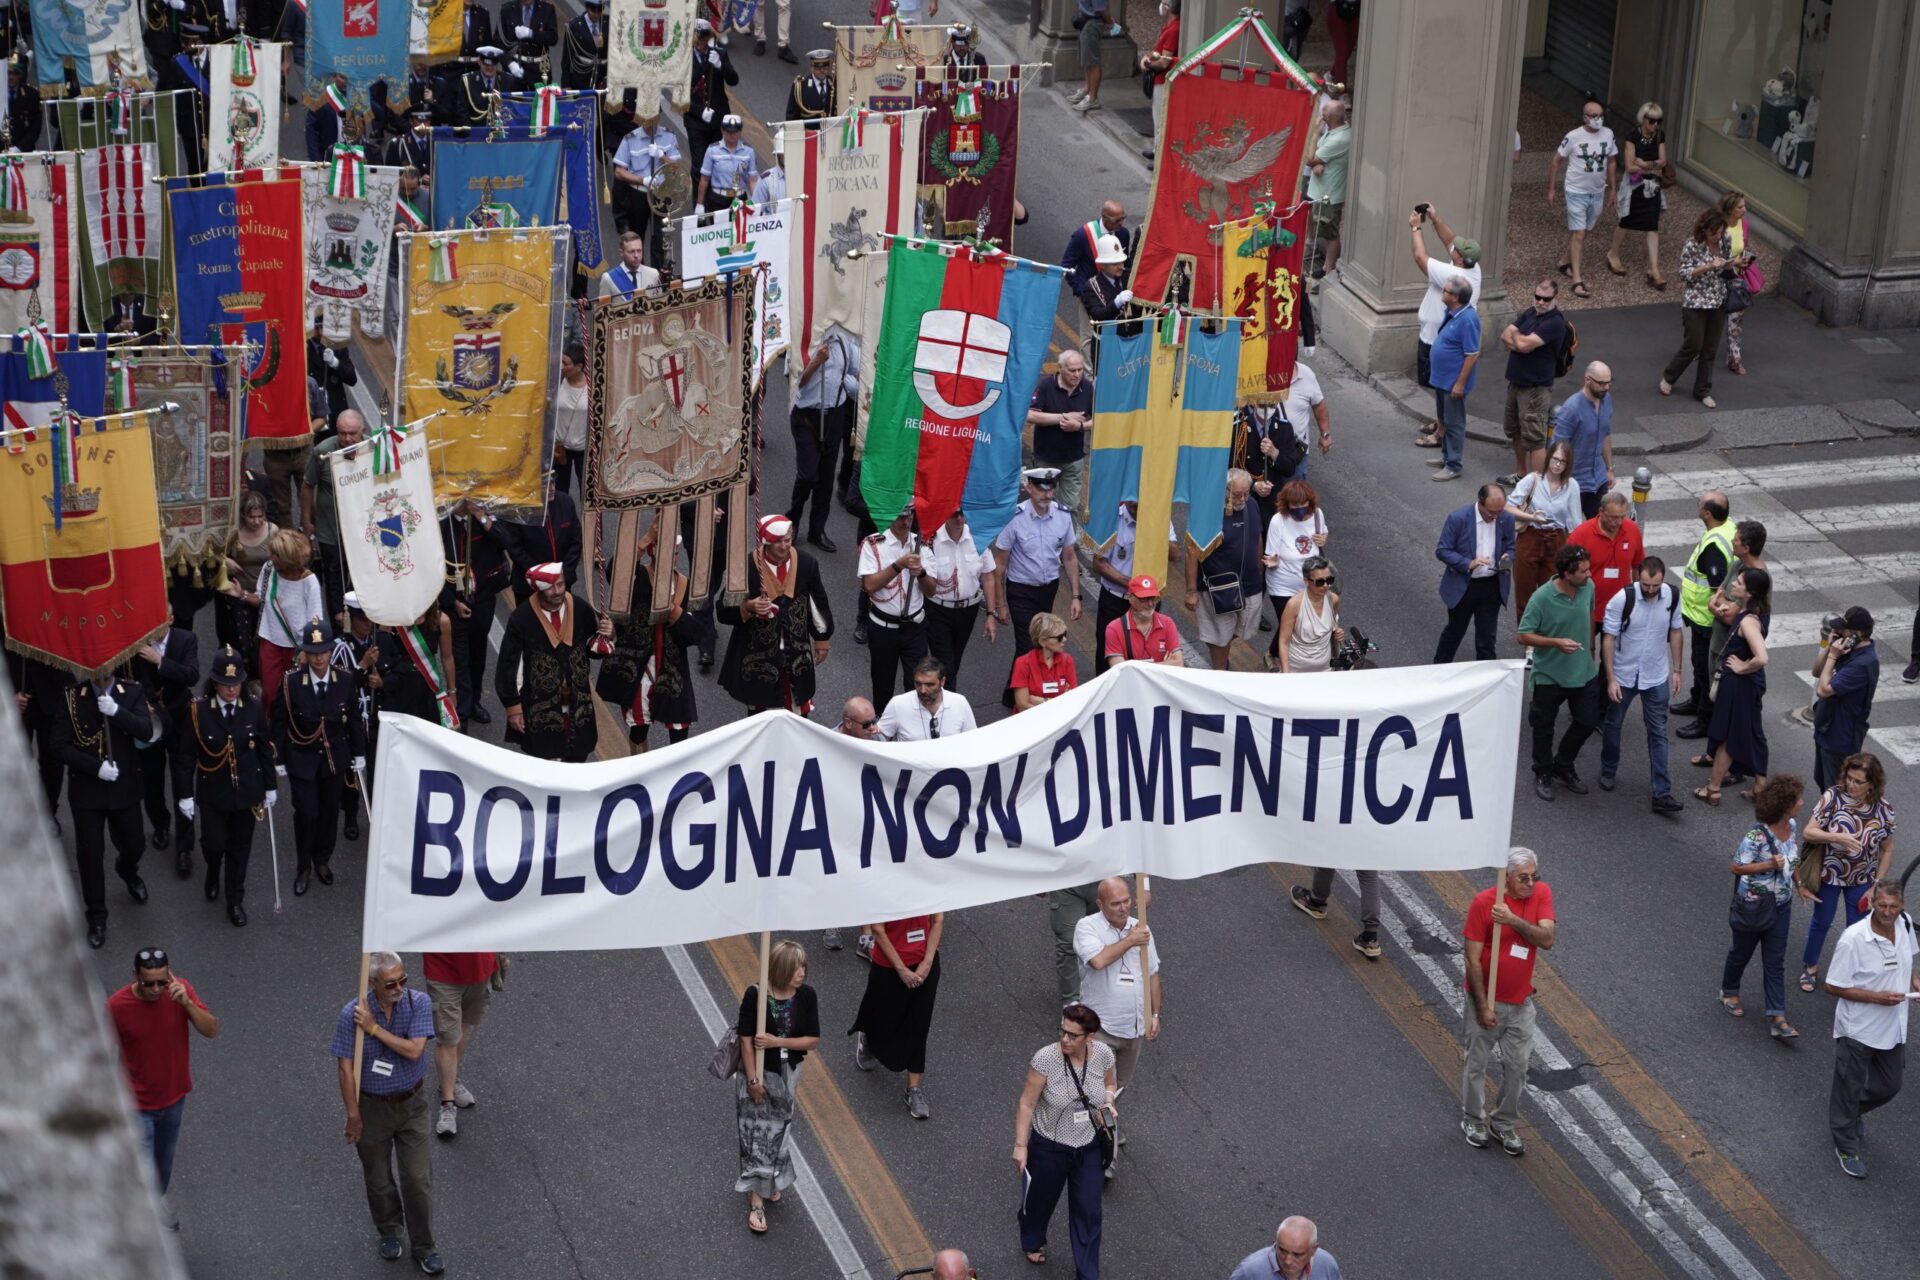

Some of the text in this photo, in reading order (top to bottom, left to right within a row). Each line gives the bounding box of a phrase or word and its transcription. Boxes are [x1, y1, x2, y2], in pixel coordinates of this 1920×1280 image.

[333, 54, 386, 66] PERUGIA
[828, 154, 880, 172] REGIONE
[827, 175, 879, 192] TOSCANA
[218, 200, 254, 216] Città
[189, 219, 289, 246] metropolitana
[690, 229, 730, 245] UNIONE
[234, 245, 245, 256] di
[198, 258, 284, 275] Roma Capitale
[614, 323, 655, 341] GENOVA
[904, 417, 992, 445] REGIONE LIGURIA
[338, 467, 370, 487] COMUNE
[41, 599, 135, 630] NAPOLI
[411, 705, 1474, 901] BOLOGNA NON DIMENTICA
